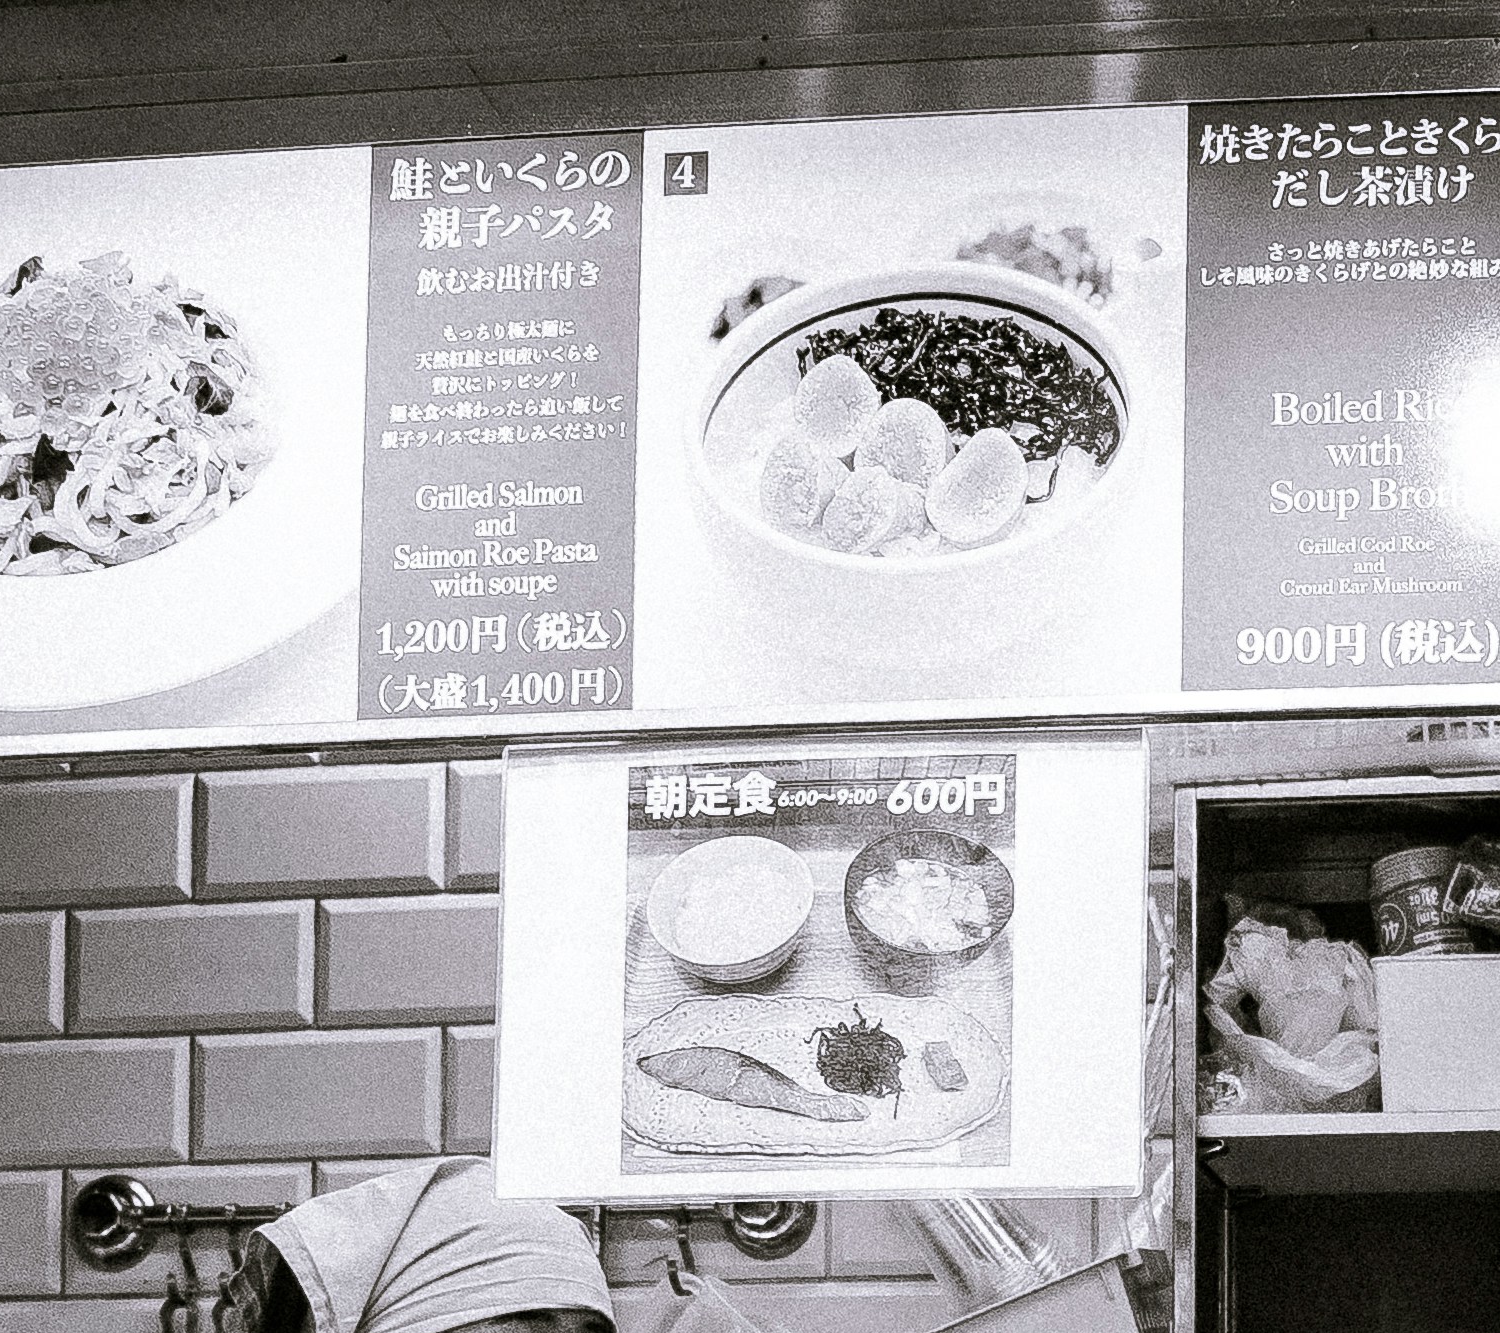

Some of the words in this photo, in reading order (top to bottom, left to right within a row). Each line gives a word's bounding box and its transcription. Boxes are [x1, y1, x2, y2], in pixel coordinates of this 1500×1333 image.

[389, 150, 632, 202] 鮭といくらの
[671, 156, 696, 189] 4
[1271, 165, 1475, 209] だし茶漬け
[417, 200, 615, 251] 親子パスタ
[1267, 237, 1476, 262] さっと焼きあげたらこと
[416, 259, 600, 297] 飲むお出汁付き
[1271, 390, 1384, 426] Boiled
[1325, 434, 1404, 467] with
[415, 482, 494, 511] Grilled
[499, 480, 584, 508] Salmon
[1269, 479, 1360, 522] Soup
[474, 510, 517, 537] and
[482, 540, 531, 567] Roe
[533, 538, 599, 565] Pasta
[1353, 557, 1386, 574] and
[431, 571, 485, 598] with
[488, 572, 558, 601] soupe
[644, 769, 778, 820] 朝定食
[886, 774, 1006, 815] 600円
